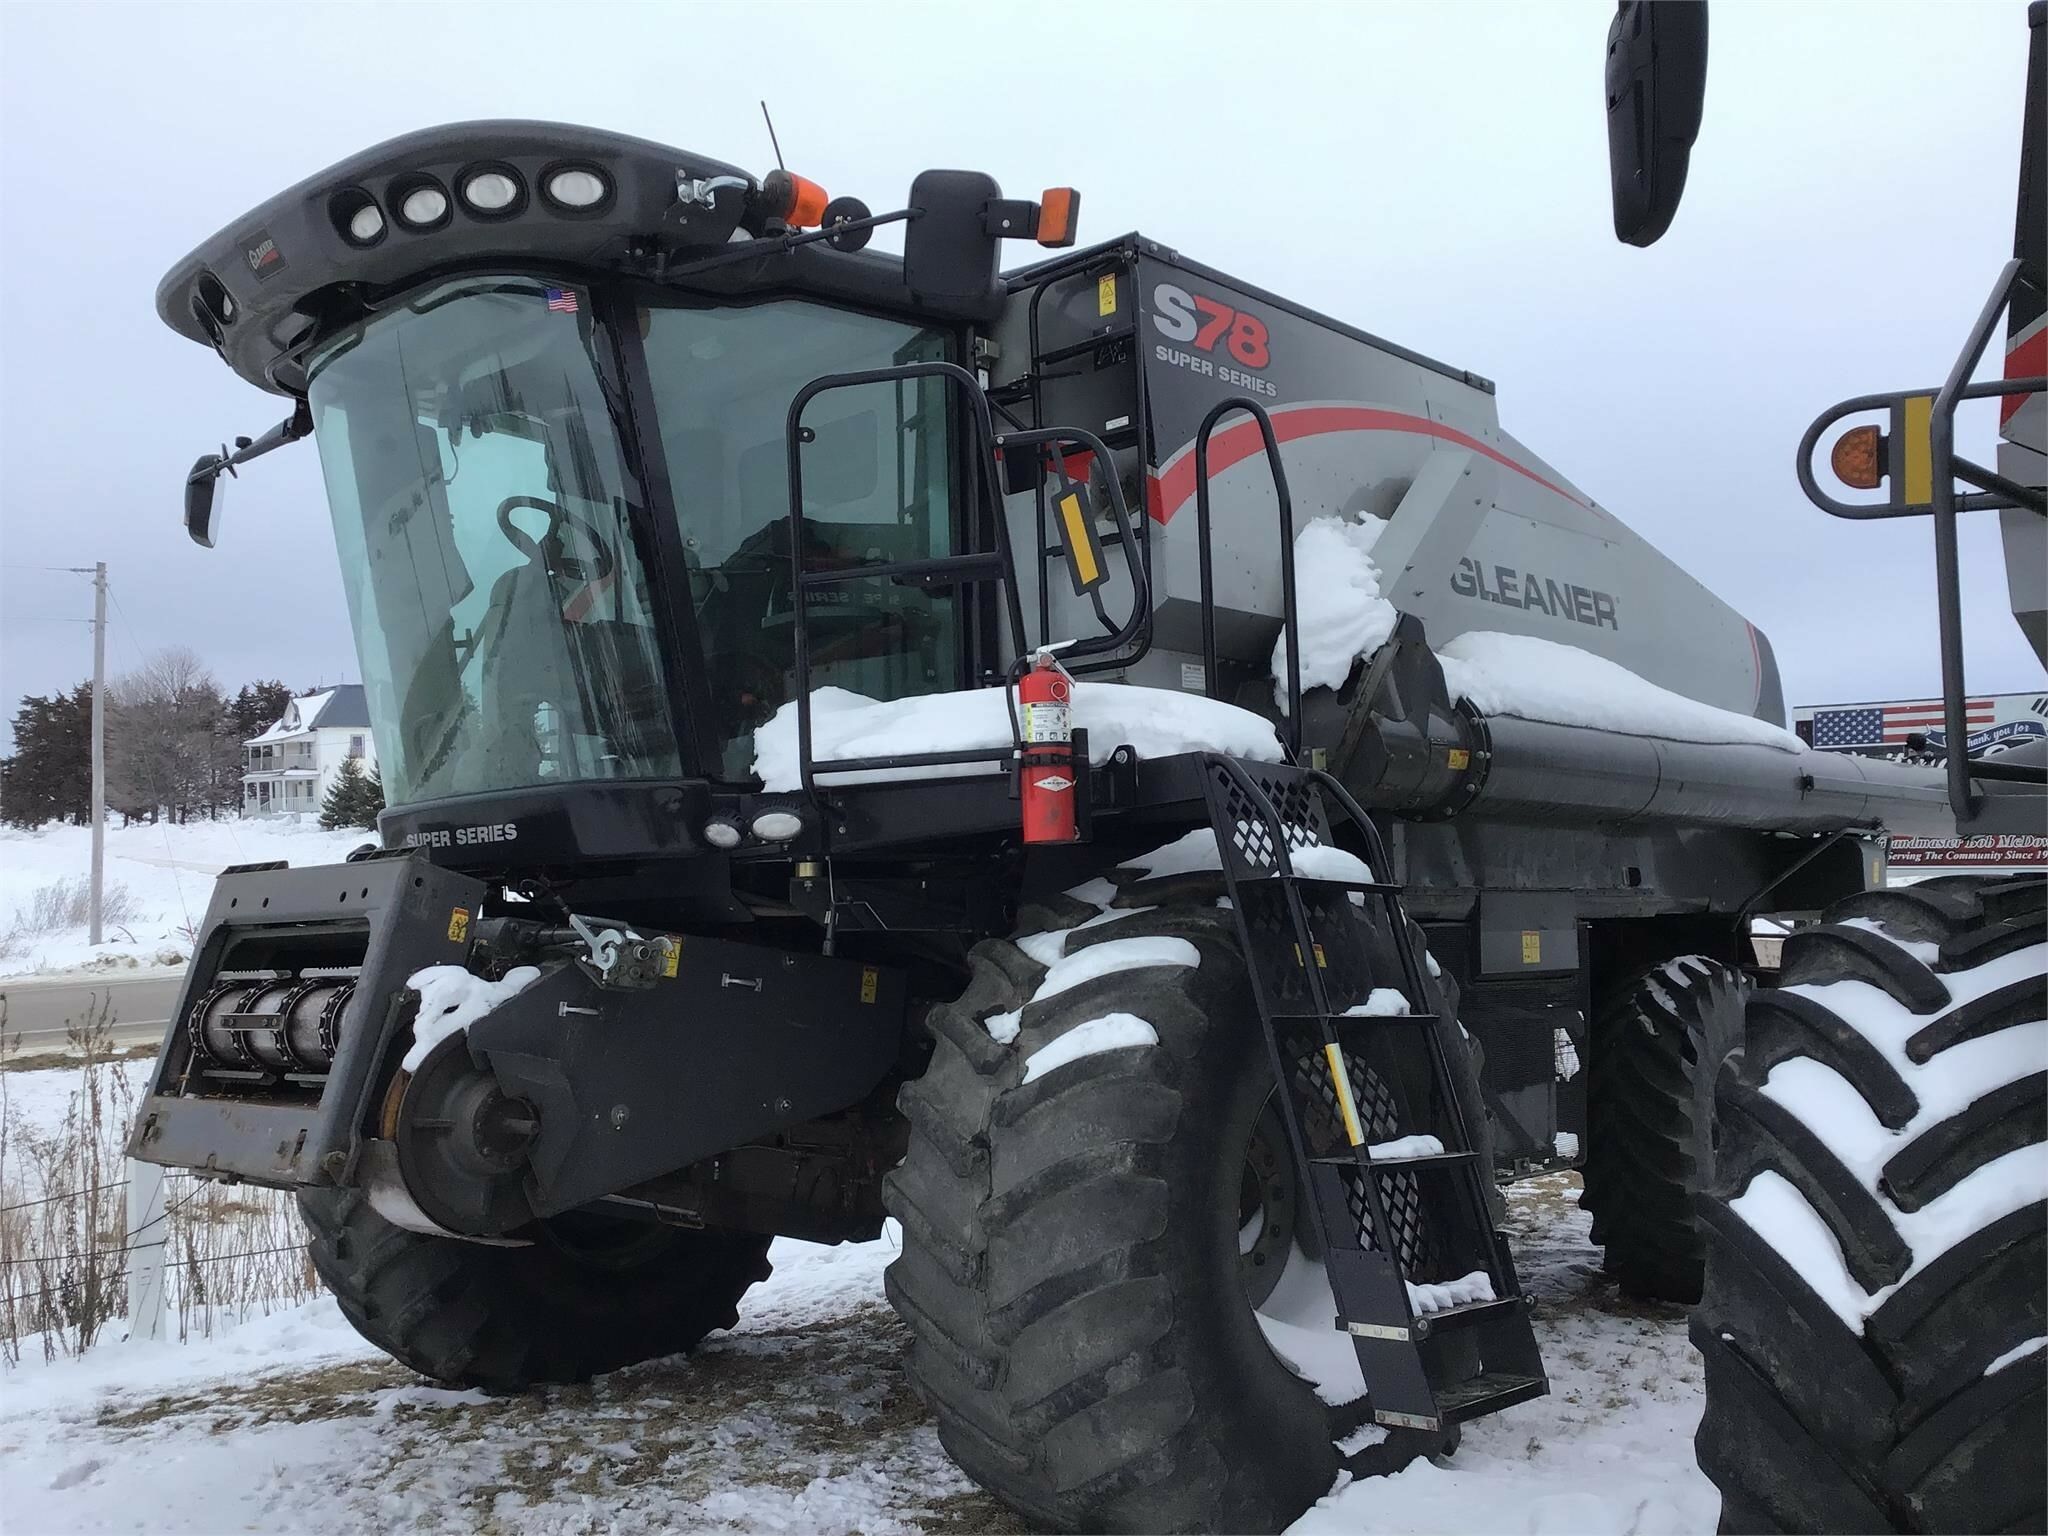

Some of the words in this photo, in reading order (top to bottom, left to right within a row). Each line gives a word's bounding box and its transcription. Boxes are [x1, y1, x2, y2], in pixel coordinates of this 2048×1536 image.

[1153, 283, 1270, 369] S78
[1155, 345, 1213, 377] SUPER
[1218, 366, 1277, 397] SERIES
[1450, 556, 1618, 631] GLEANER
[1967, 733, 1992, 748] hank
[1993, 727, 2010, 741] you
[2013, 723, 2030, 735] for
[406, 830, 450, 848] SUPER
[456, 823, 518, 846] SERIES
[1888, 851, 1922, 861] Serving
[1925, 851, 1943, 860] The
[1945, 850, 2003, 862] Community
[2005, 850, 2034, 860] Since
